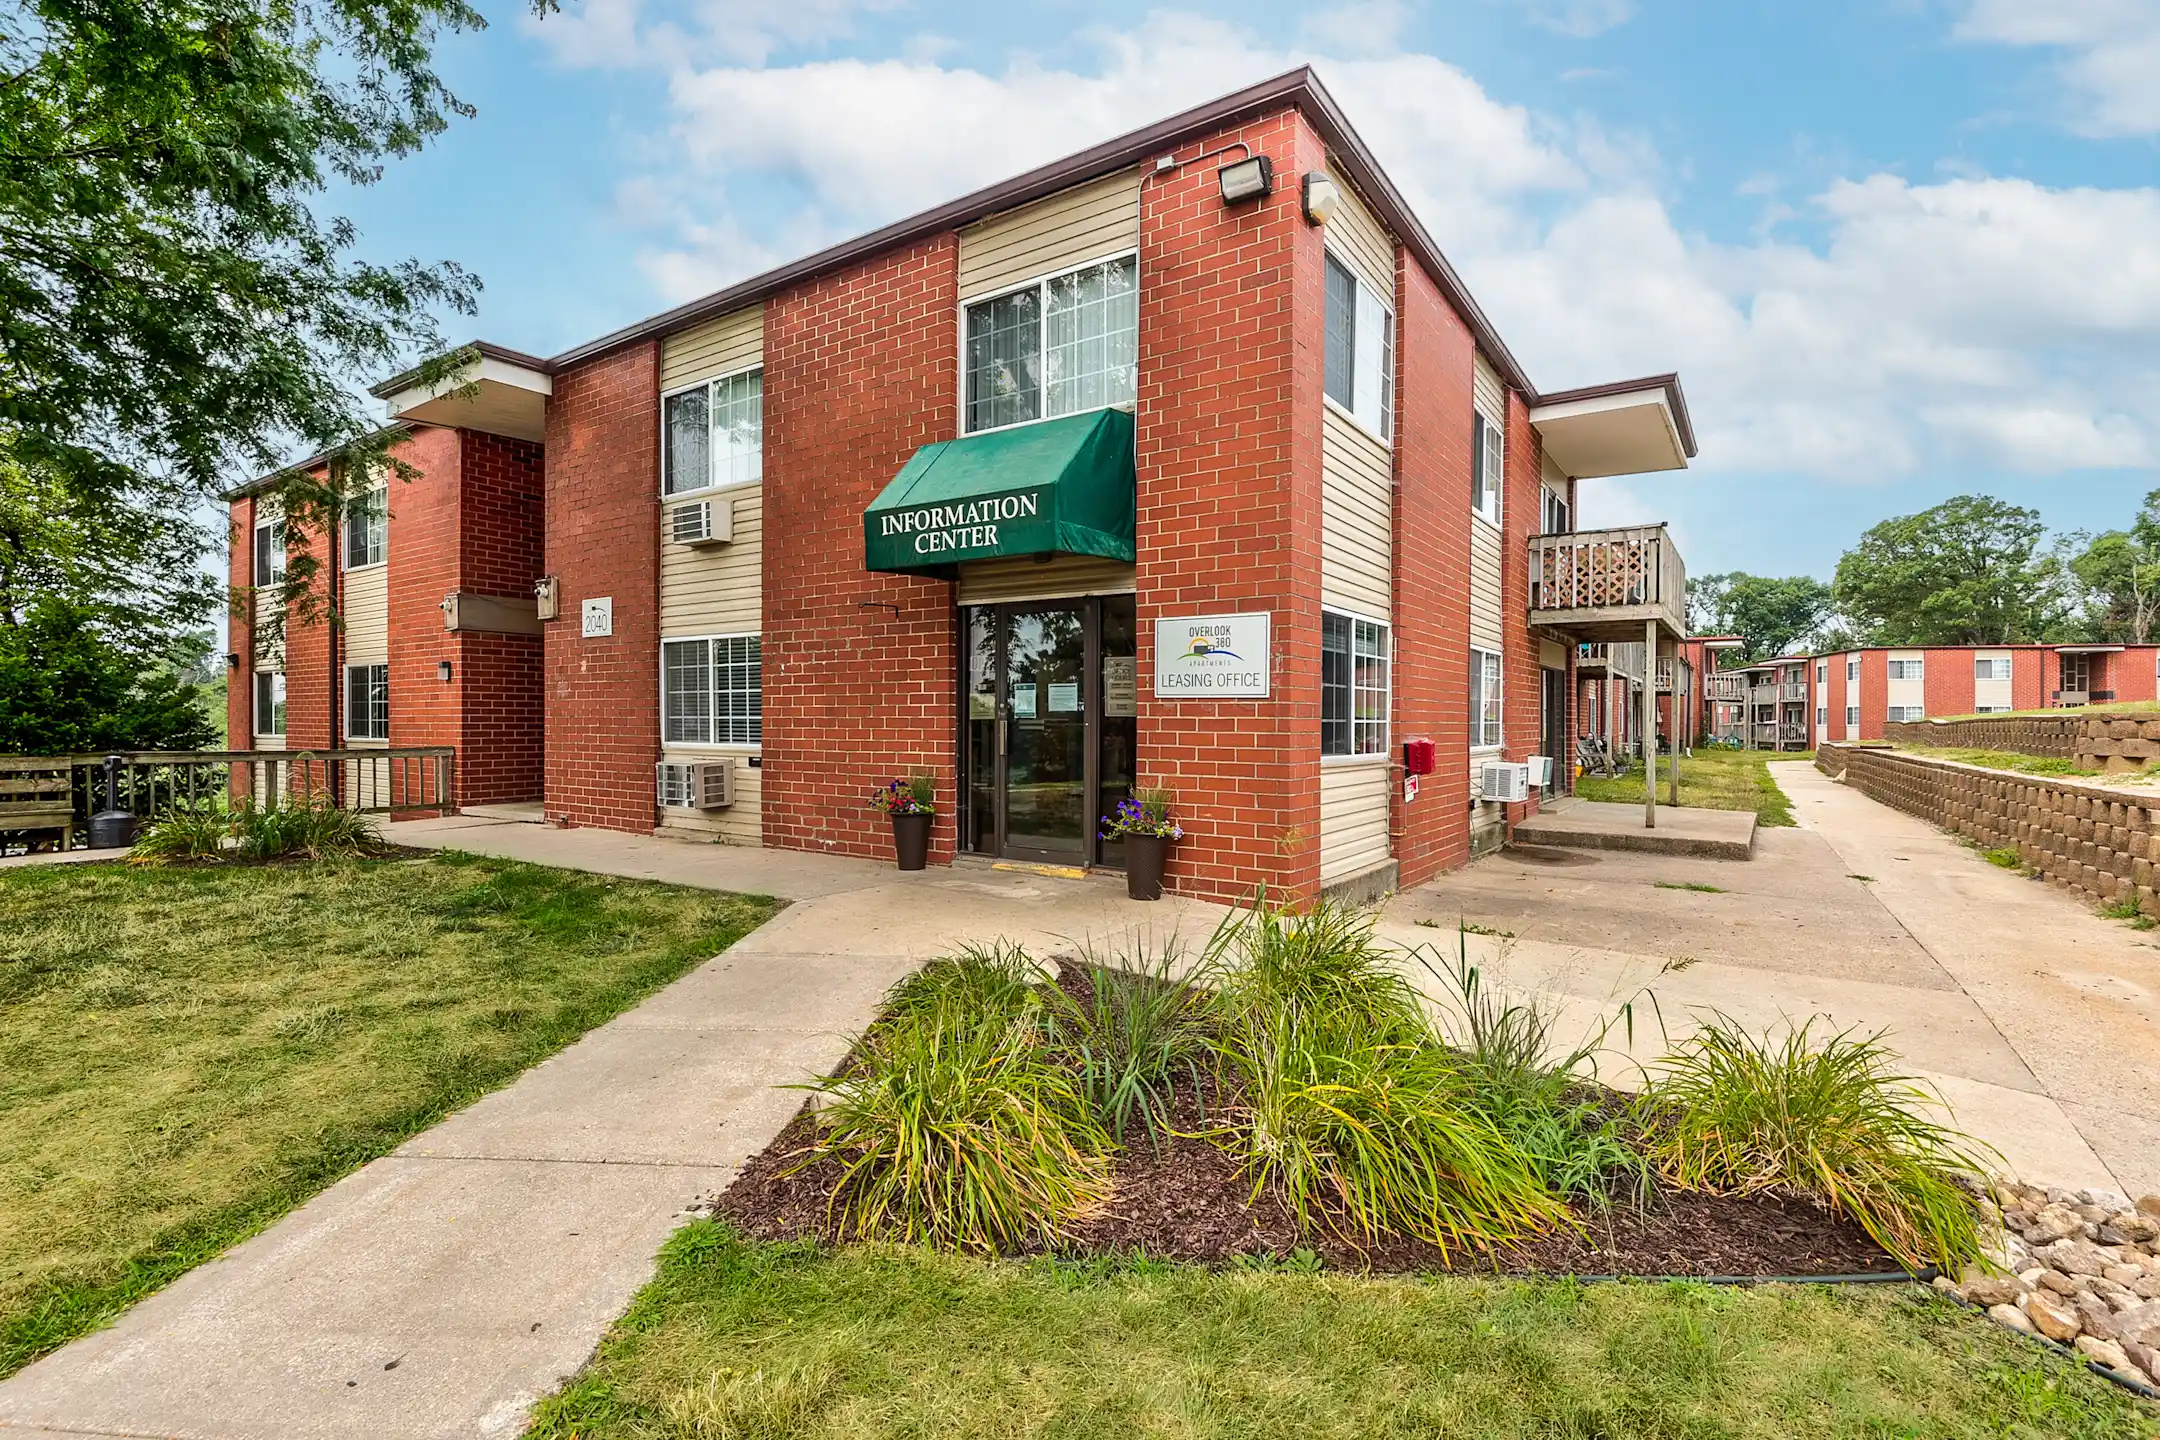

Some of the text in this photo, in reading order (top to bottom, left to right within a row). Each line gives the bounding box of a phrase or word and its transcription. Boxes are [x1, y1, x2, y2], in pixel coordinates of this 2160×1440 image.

[881, 493, 1038, 536] INFORMATION
[915, 525, 998, 554] CENTER
[585, 614, 608, 632] 2040
[1189, 625, 1231, 637] OVERLOOK
[1215, 637, 1231, 648] 380
[1162, 673, 1212, 688] LEASING
[1216, 672, 1261, 687] OFFICE
